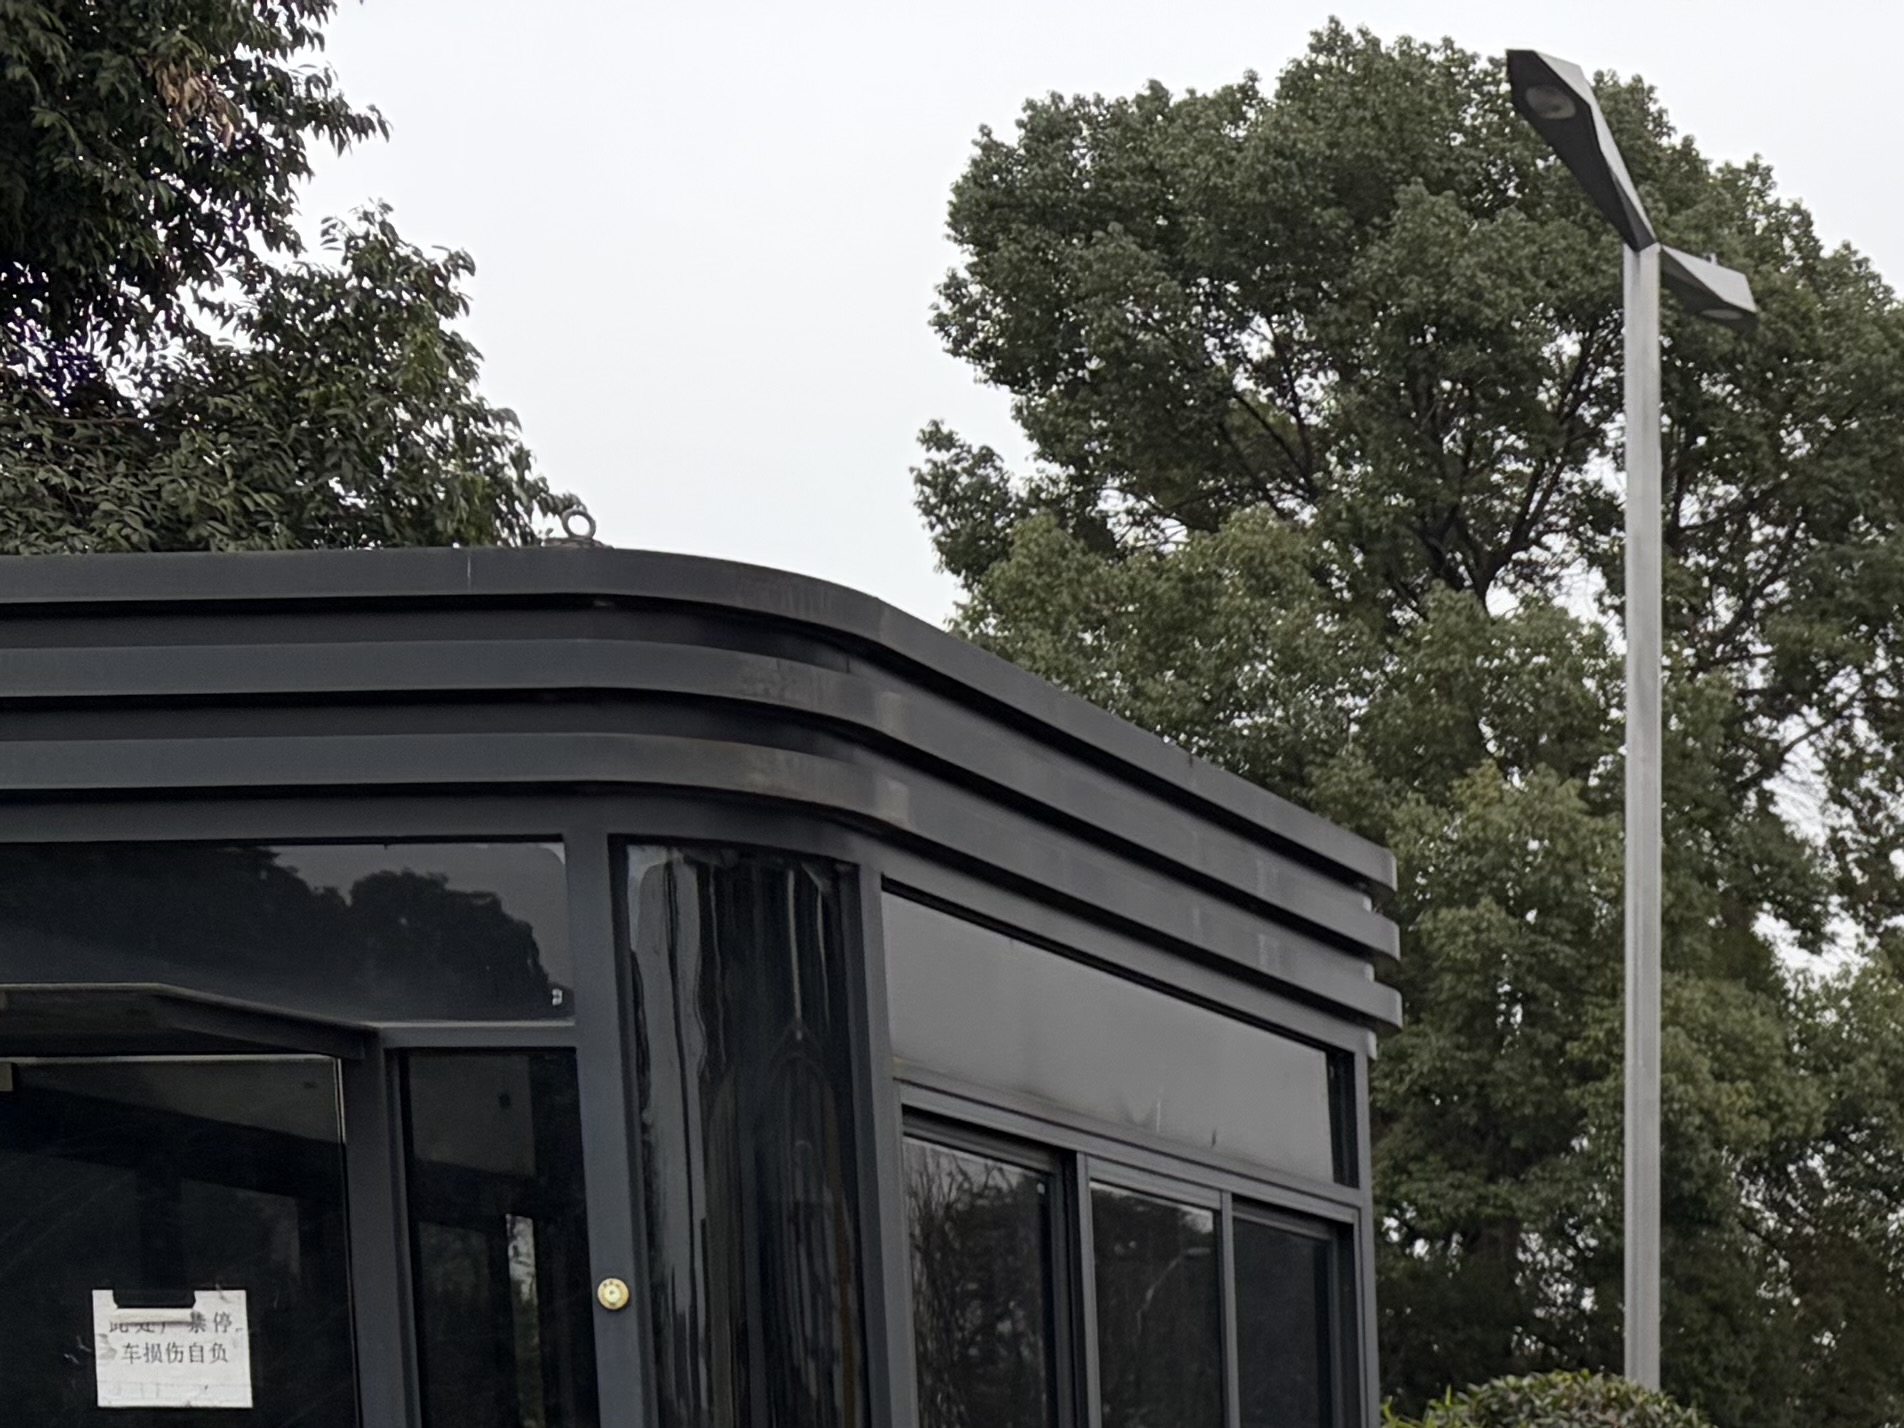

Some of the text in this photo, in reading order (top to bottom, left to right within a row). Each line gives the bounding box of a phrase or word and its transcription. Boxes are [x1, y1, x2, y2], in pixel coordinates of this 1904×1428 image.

[122, 1342, 229, 1364] 车损伤自负
